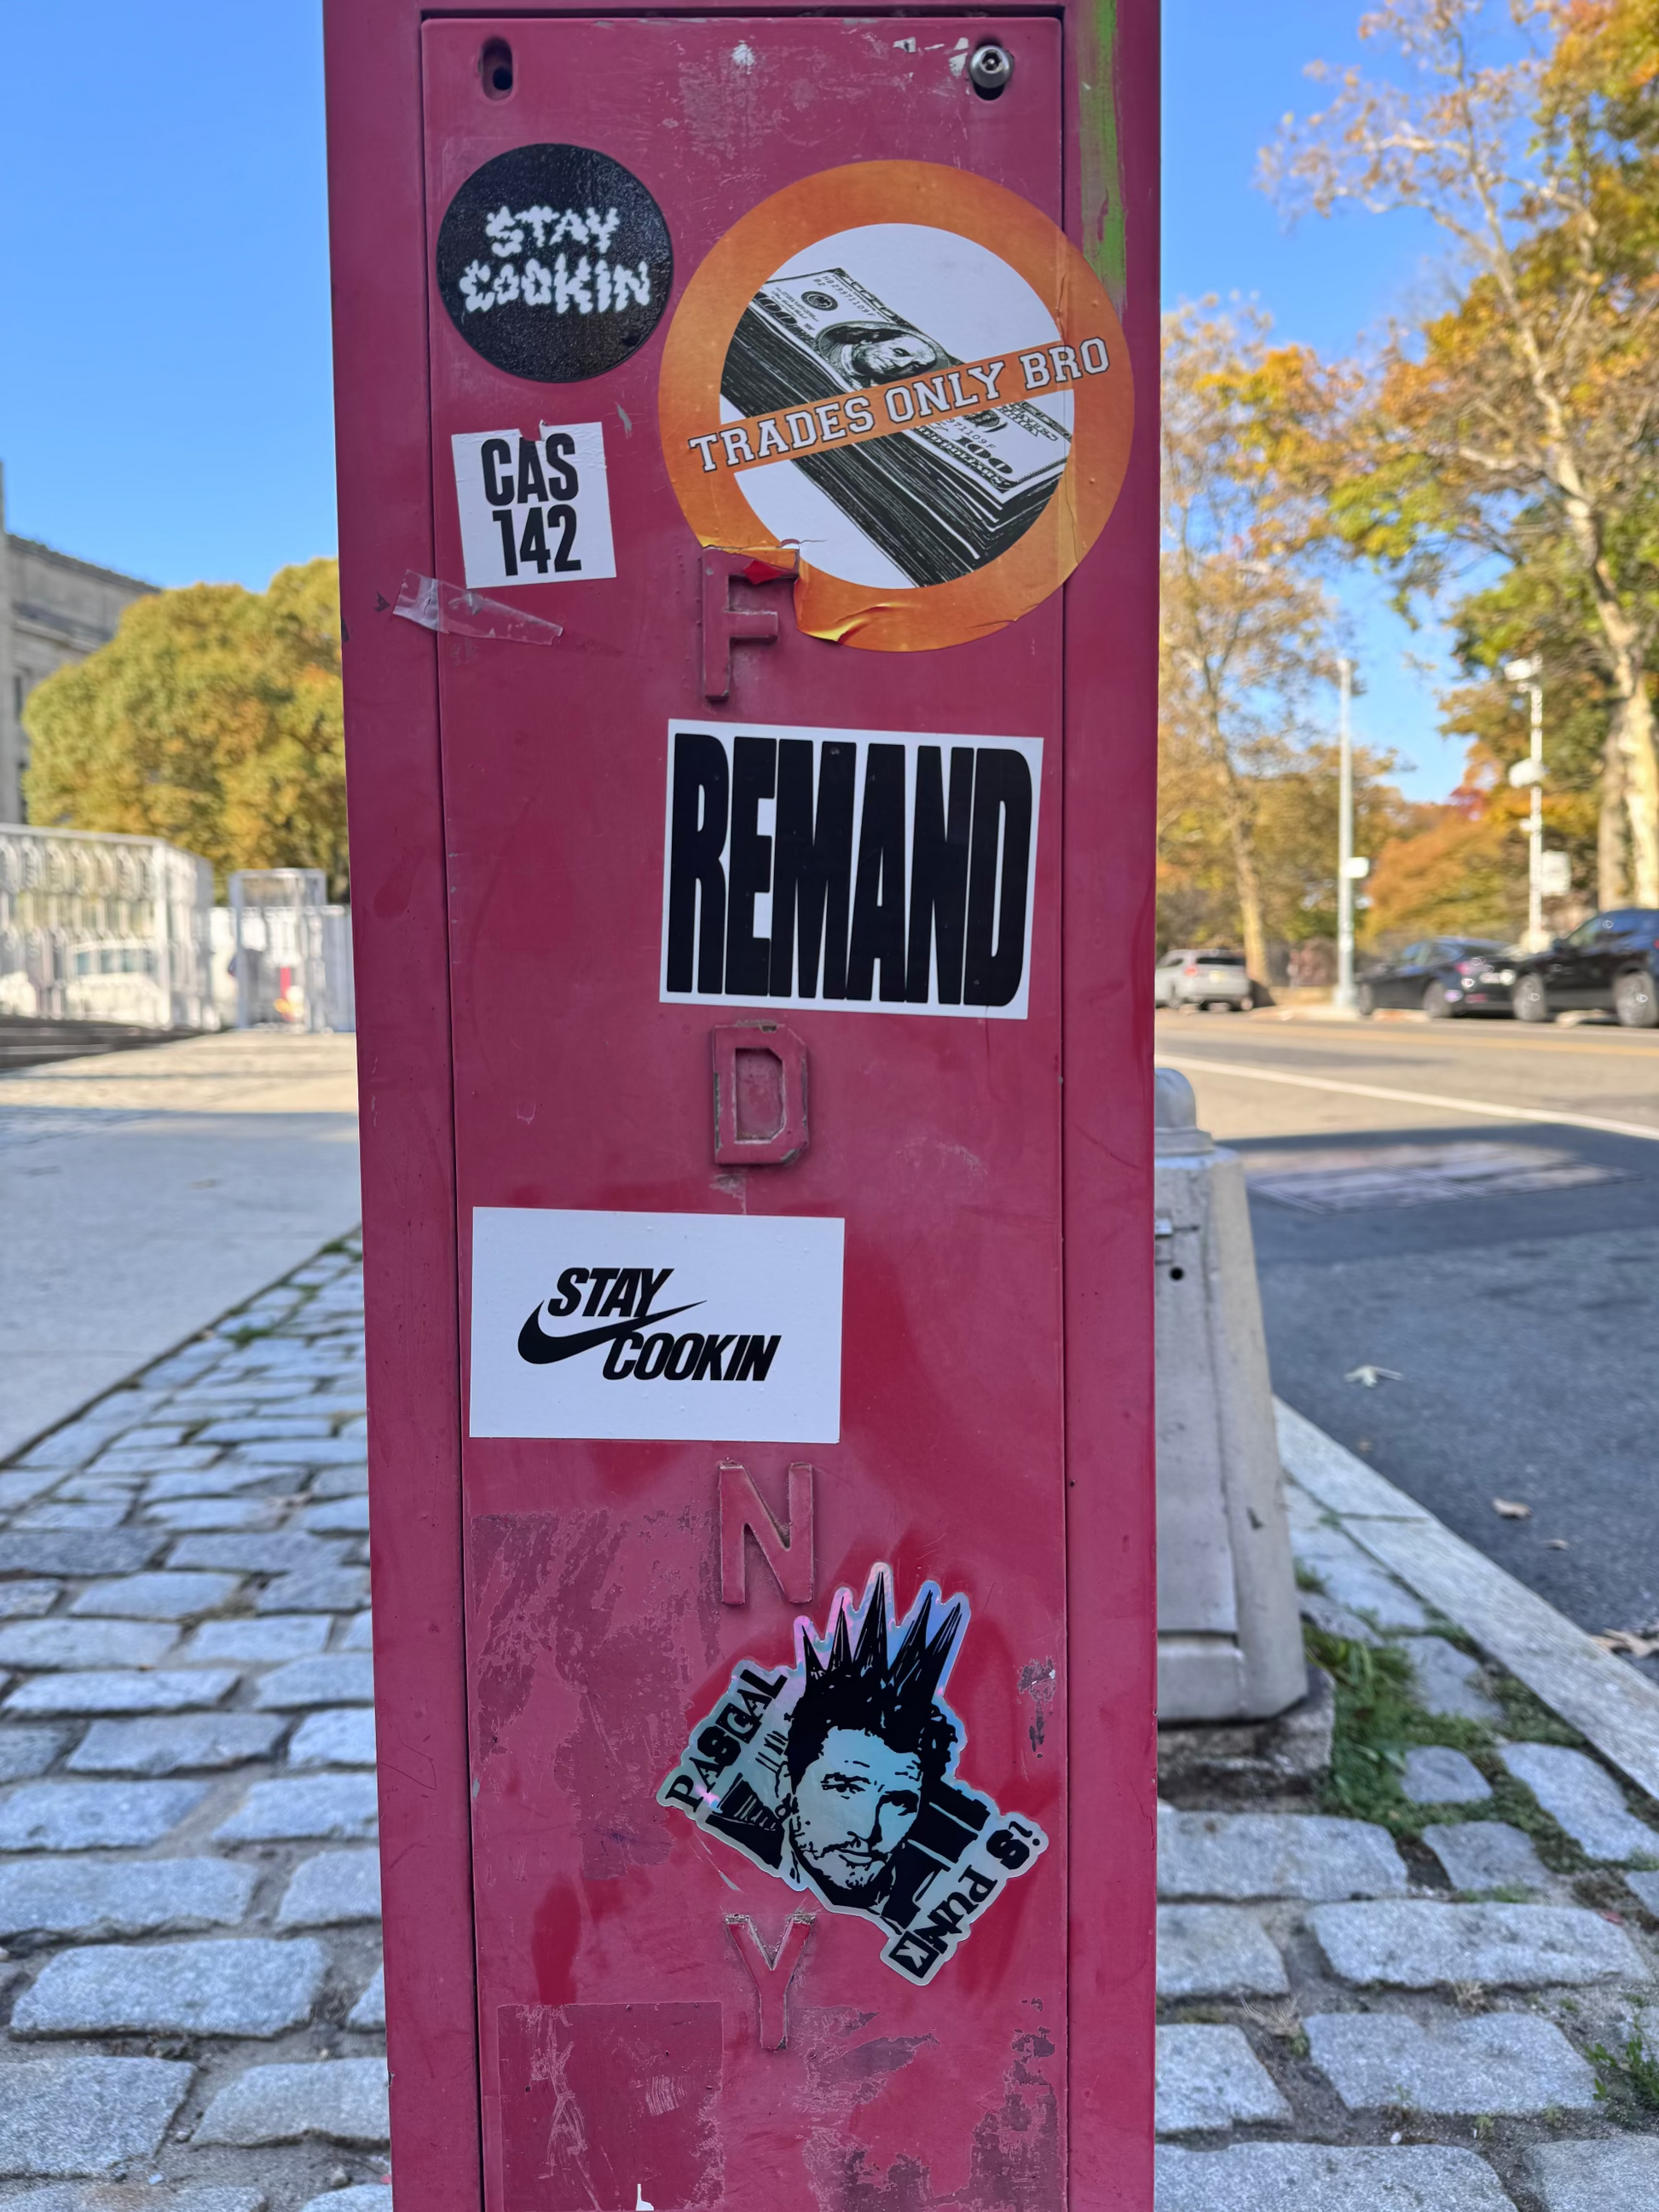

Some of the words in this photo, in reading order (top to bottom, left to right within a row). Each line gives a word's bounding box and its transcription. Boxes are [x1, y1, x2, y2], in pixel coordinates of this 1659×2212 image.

[486, 205, 621, 257] STAY
[459, 252, 650, 314] COOKIN
[688, 396, 875, 473] TRADES
[884, 361, 1007, 421] ONLY
[1019, 336, 1111, 391] BRO
[481, 432, 580, 506] CAS
[951, 435, 1014, 475] 100
[492, 504, 582, 577] 142
[666, 732, 1033, 1008] REMAND
[547, 1267, 675, 1318] STAY
[602, 1331, 783, 1382] COOKIN
[665, 1668, 789, 1813] PASCAL
